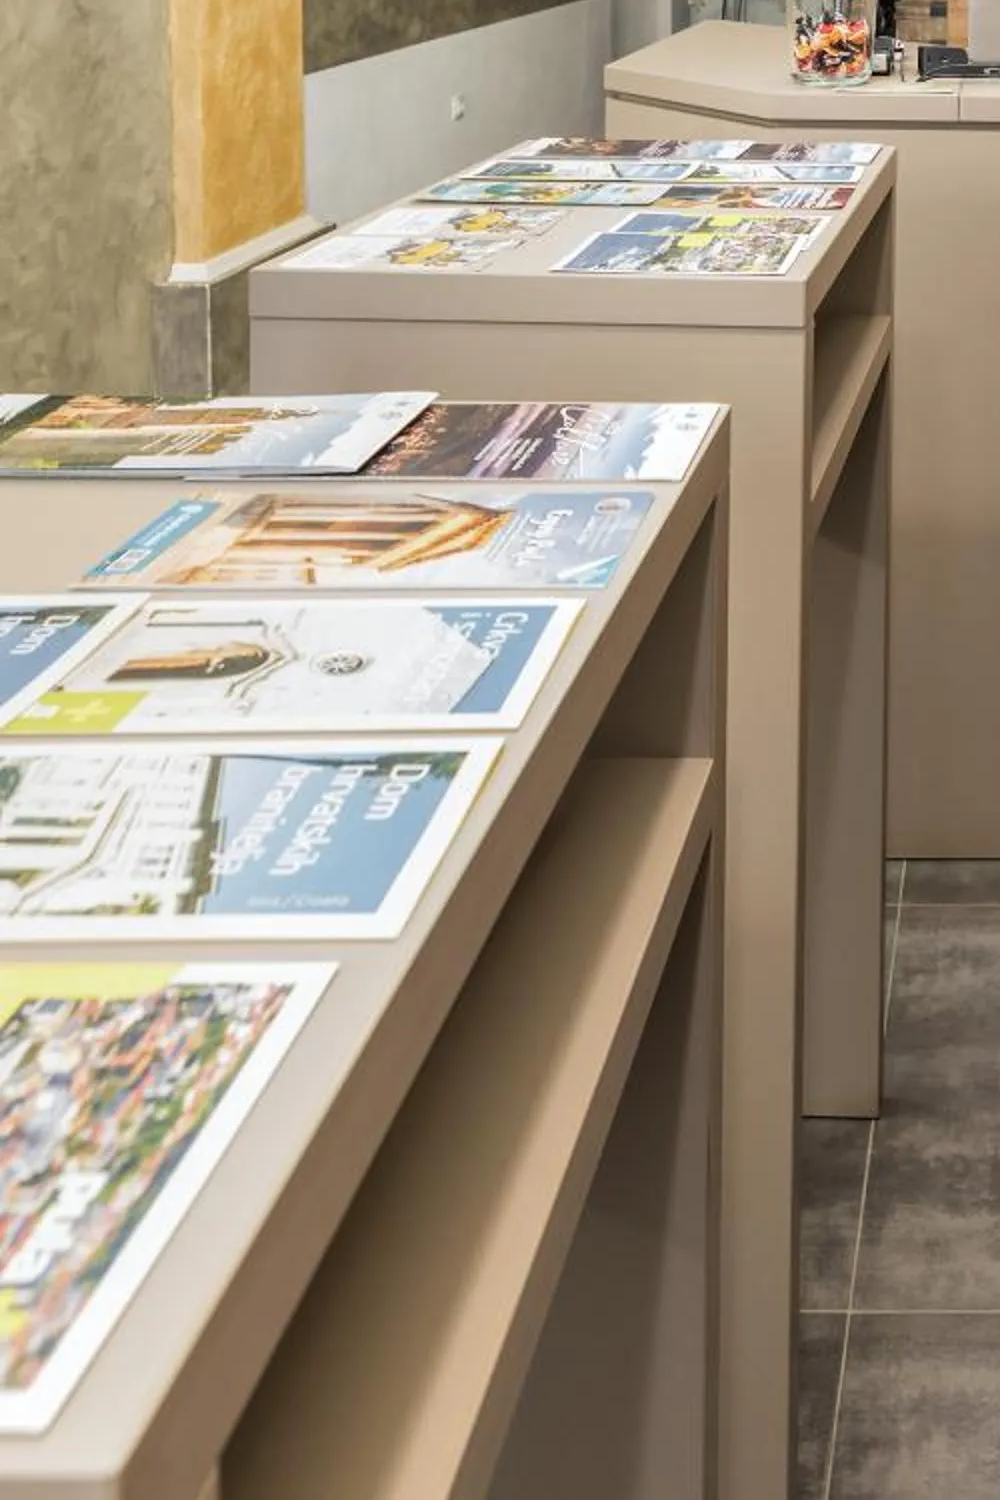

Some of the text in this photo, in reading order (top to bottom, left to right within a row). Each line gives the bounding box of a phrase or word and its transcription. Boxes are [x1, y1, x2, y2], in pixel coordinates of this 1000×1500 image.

[9, 614, 80, 655] Dom
[268, 763, 378, 876] hrvatskih
[363, 763, 431, 820] Dom
